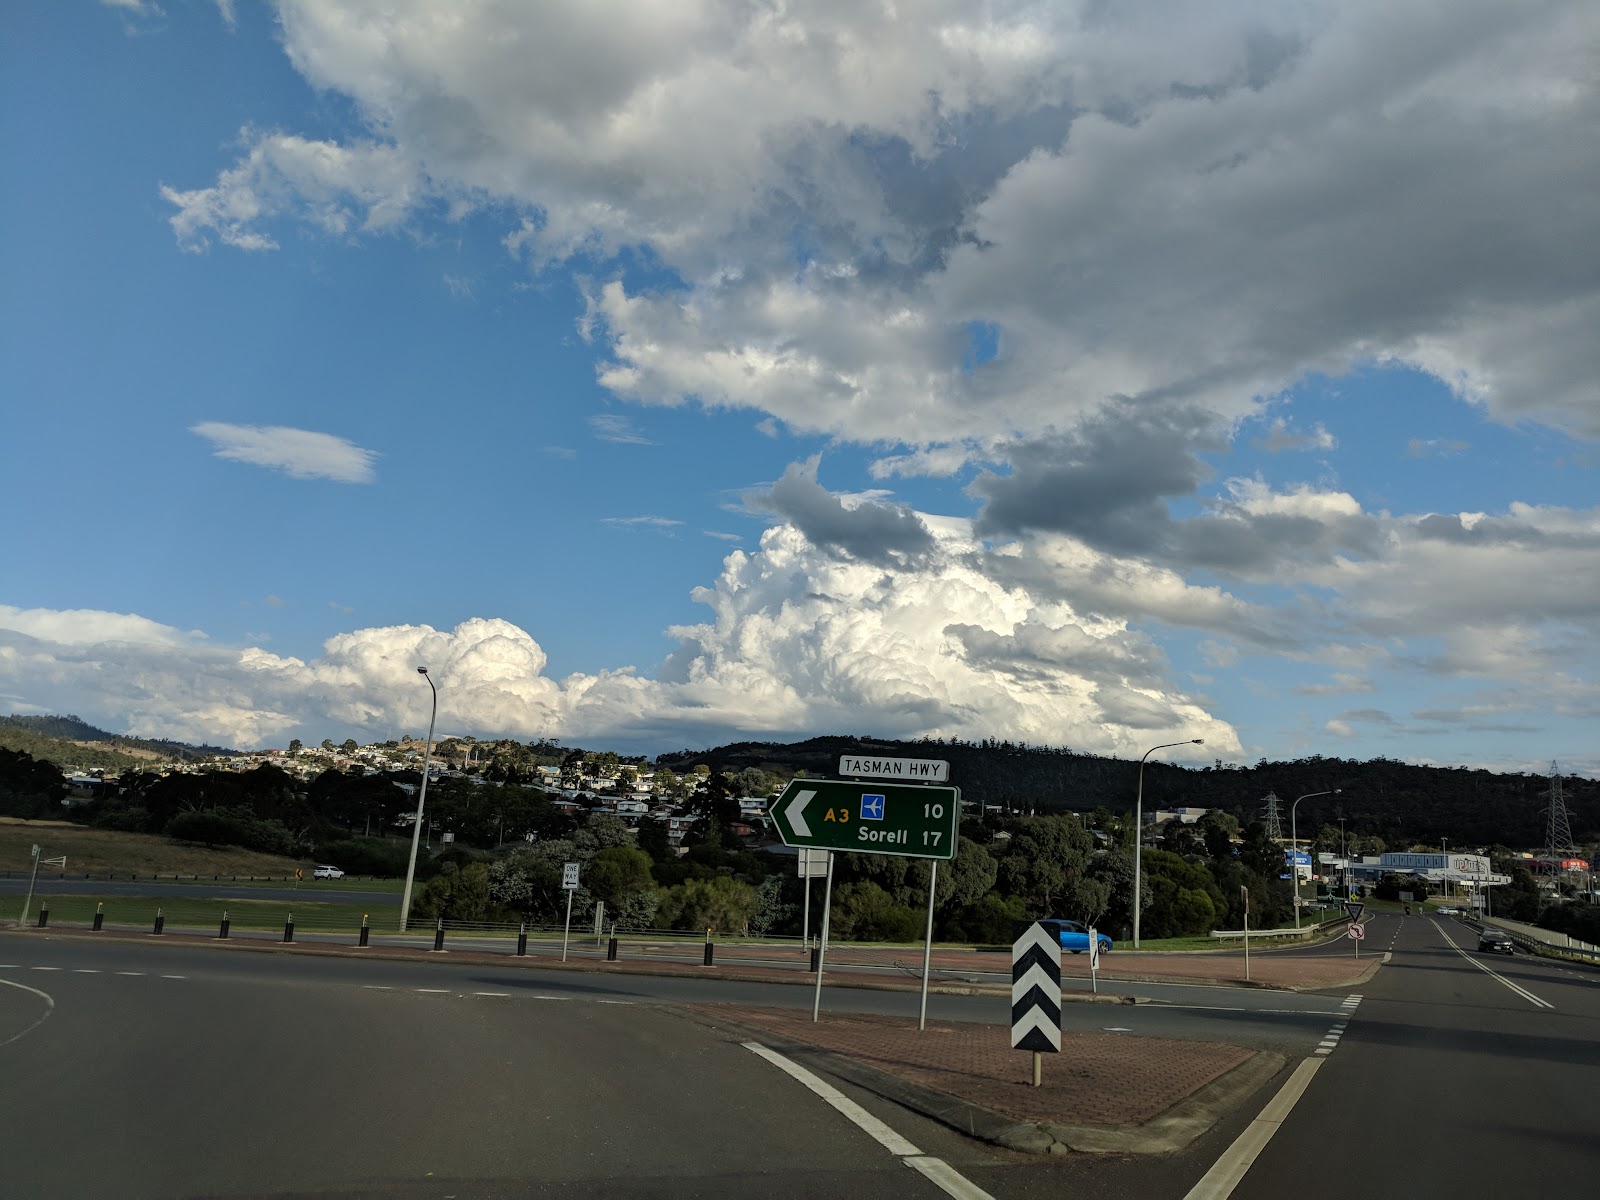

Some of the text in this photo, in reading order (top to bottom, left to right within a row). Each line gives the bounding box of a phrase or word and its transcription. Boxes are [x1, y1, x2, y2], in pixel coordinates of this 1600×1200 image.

[845, 759, 941, 776] TASMAN HWY
[823, 807, 850, 823] A3
[924, 803, 944, 819] 10
[857, 826, 942, 847] Sorell 17
